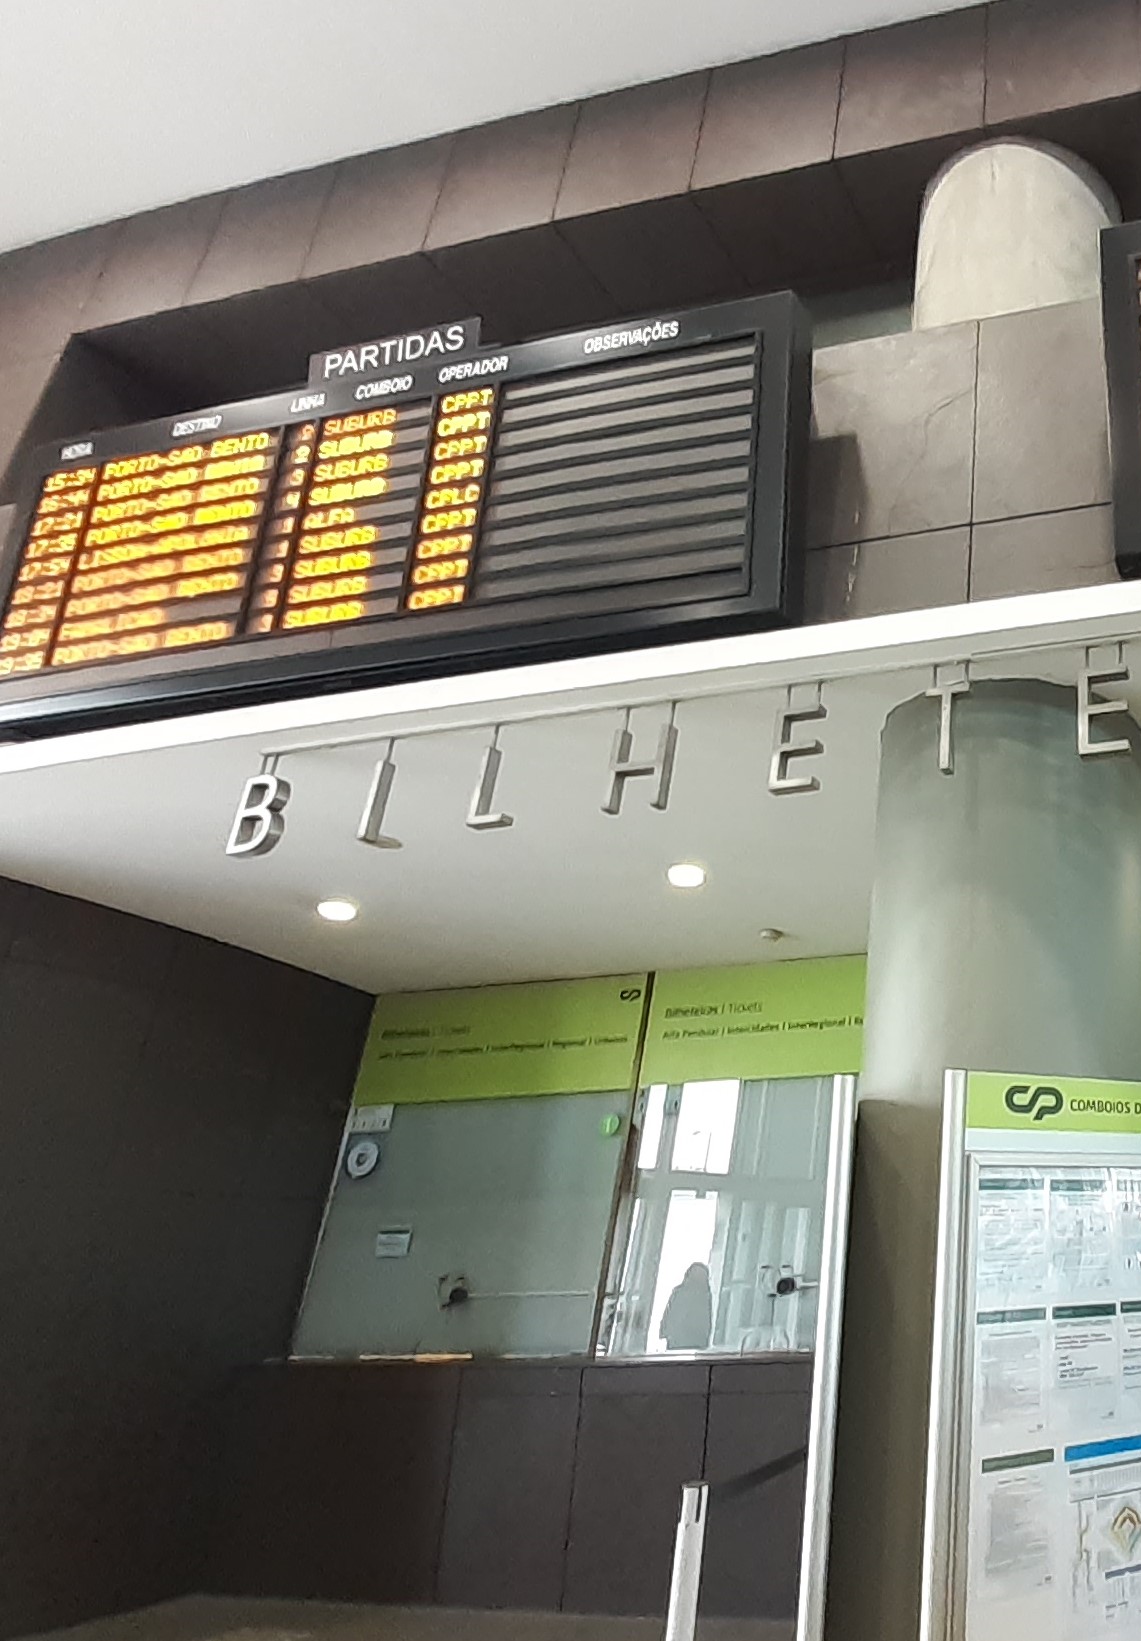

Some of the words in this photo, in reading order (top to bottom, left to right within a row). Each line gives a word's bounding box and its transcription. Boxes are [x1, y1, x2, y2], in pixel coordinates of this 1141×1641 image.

[290, 392, 326, 413] LINHA
[355, 374, 414, 400] COMBOIO
[438, 356, 509, 383] OPERADOR
[584, 320, 680, 354] OBSERVAÇÕES
[323, 325, 465, 380] PARTIDAS
[324, 408, 397, 436] SUBURB
[442, 388, 493, 414] CPPT
[437, 411, 491, 437] CPPT
[314, 453, 389, 482] SUBURB
[434, 435, 487, 461] CPPT
[430, 458, 485, 484] CPPT
[421, 508, 476, 534] CPPT
[1070, 1098, 1131, 1114] COMBOIOS
